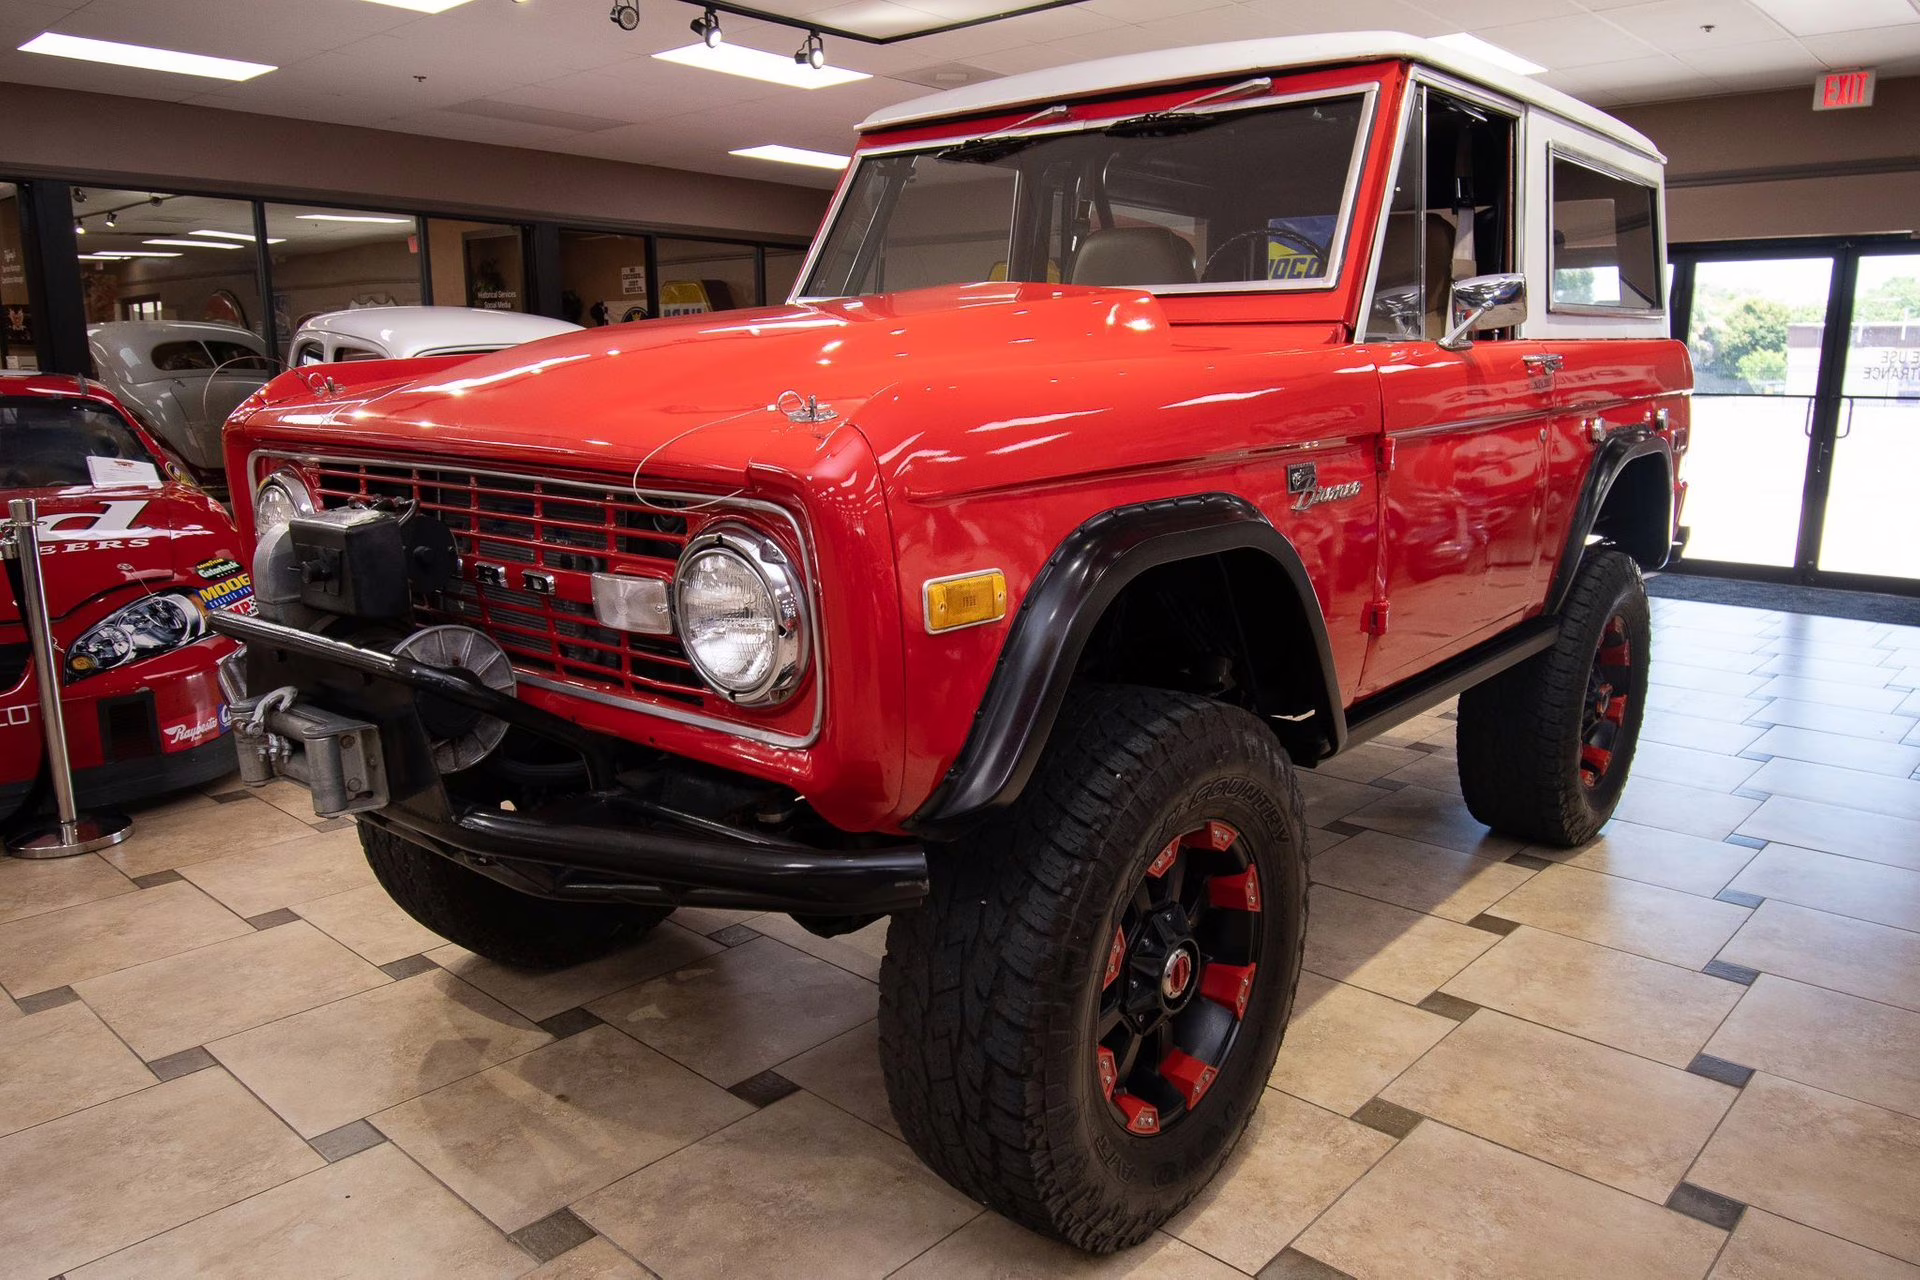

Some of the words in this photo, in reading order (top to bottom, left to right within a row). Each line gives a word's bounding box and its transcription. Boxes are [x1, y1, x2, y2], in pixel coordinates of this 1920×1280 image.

[1823, 72, 1869, 107] EXIT
[1268, 257, 1322, 280] OCO
[40, 538, 150, 556] EERS
[199, 573, 251, 603] MOOG
[1188, 776, 1291, 844] COUNTRY
